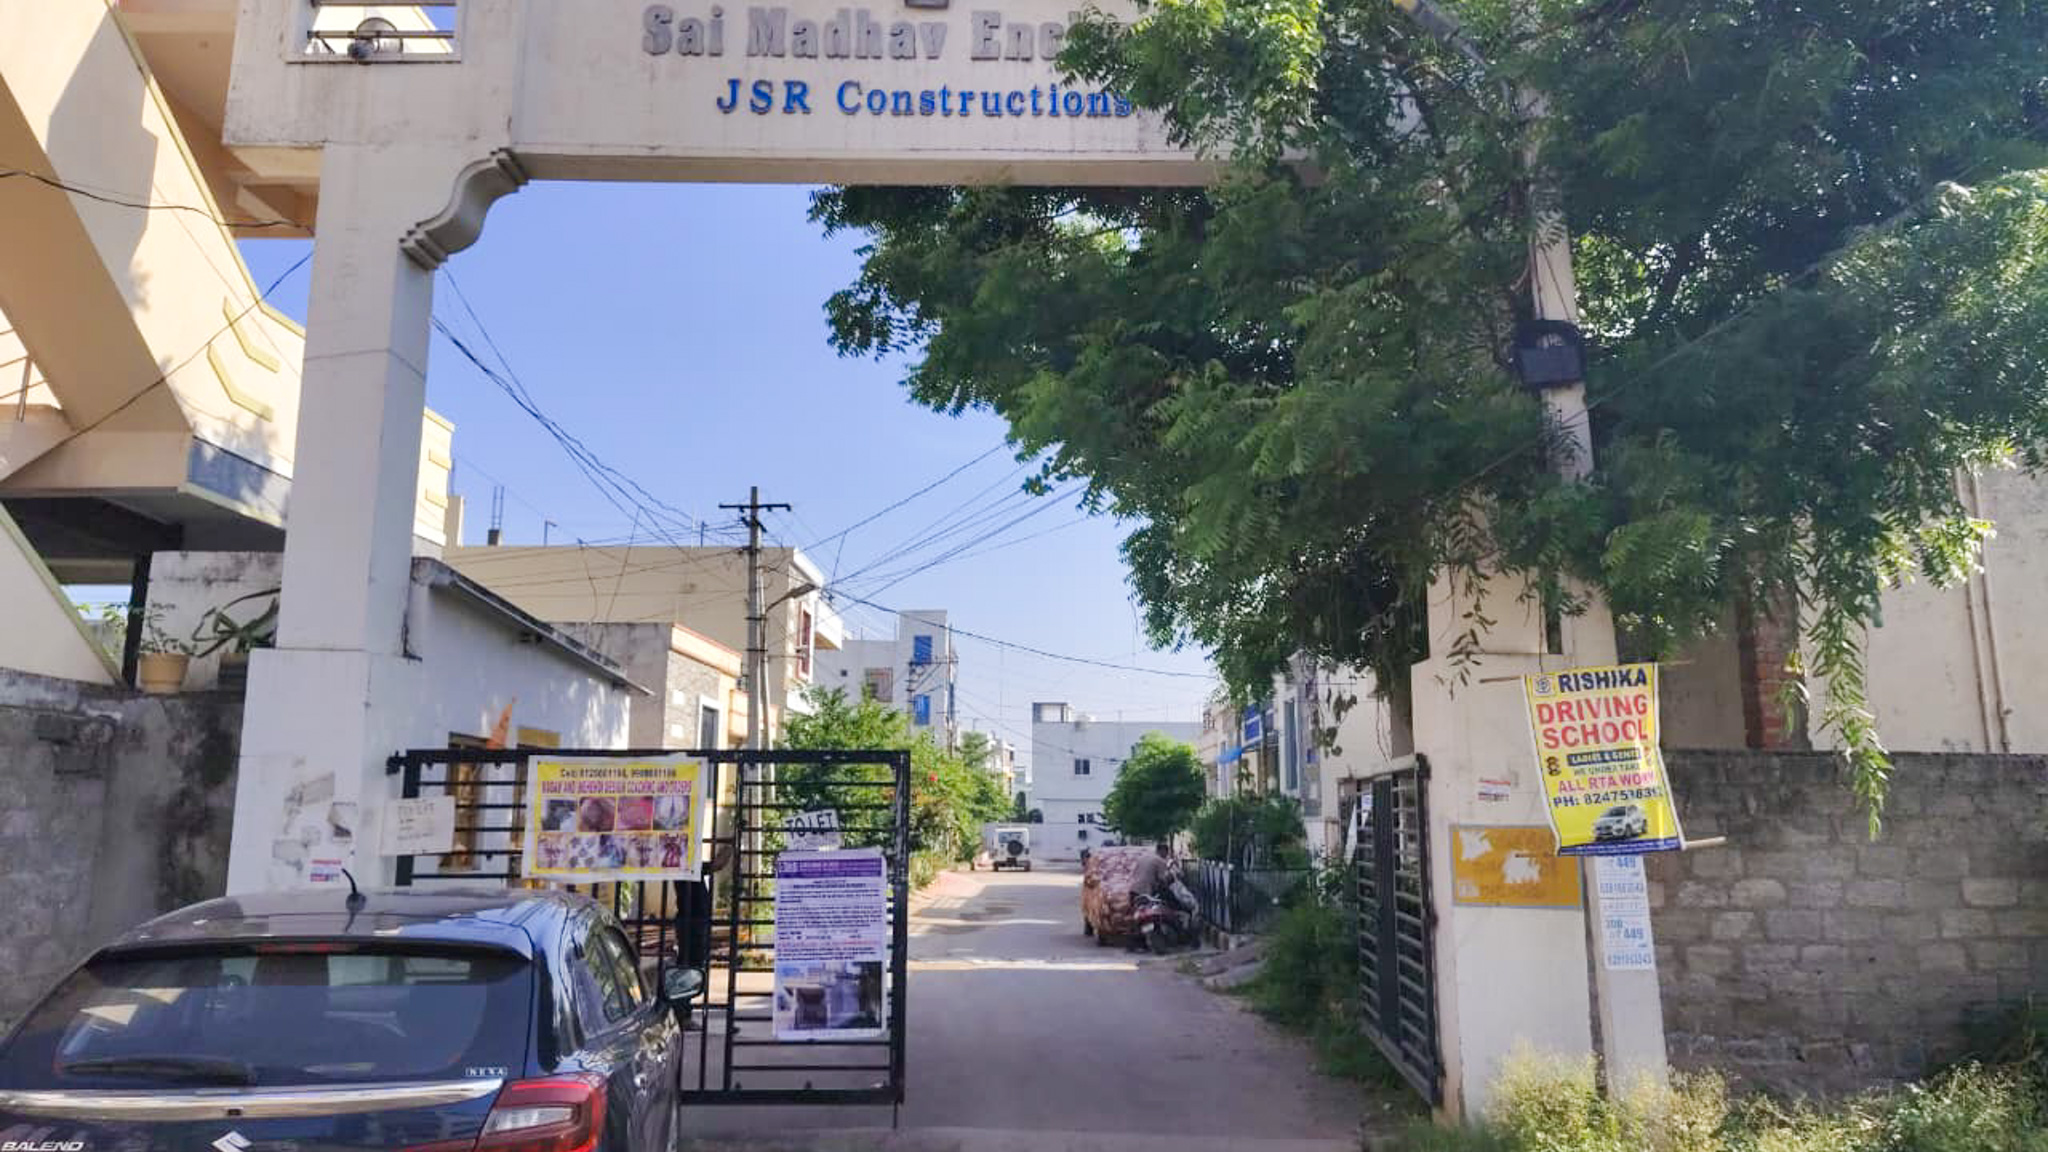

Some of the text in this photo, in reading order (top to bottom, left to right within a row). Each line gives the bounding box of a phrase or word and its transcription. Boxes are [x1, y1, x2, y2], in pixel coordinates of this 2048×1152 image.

[643, 4, 724, 56] Sai
[746, 7, 948, 60] Madhav
[717, 79, 1132, 118] JSR Constructions
[1558, 667, 1648, 693] RISHIKA
[1536, 694, 1648, 725] DRIVING
[1542, 719, 1649, 749] SCHOOL
[1558, 780, 1585, 793] ALL
[1588, 776, 1618, 790] RTA
[1553, 795, 1580, 807] PH:
[785, 817, 806, 839] TO
[1, 1141, 84, 1152] BALENO
